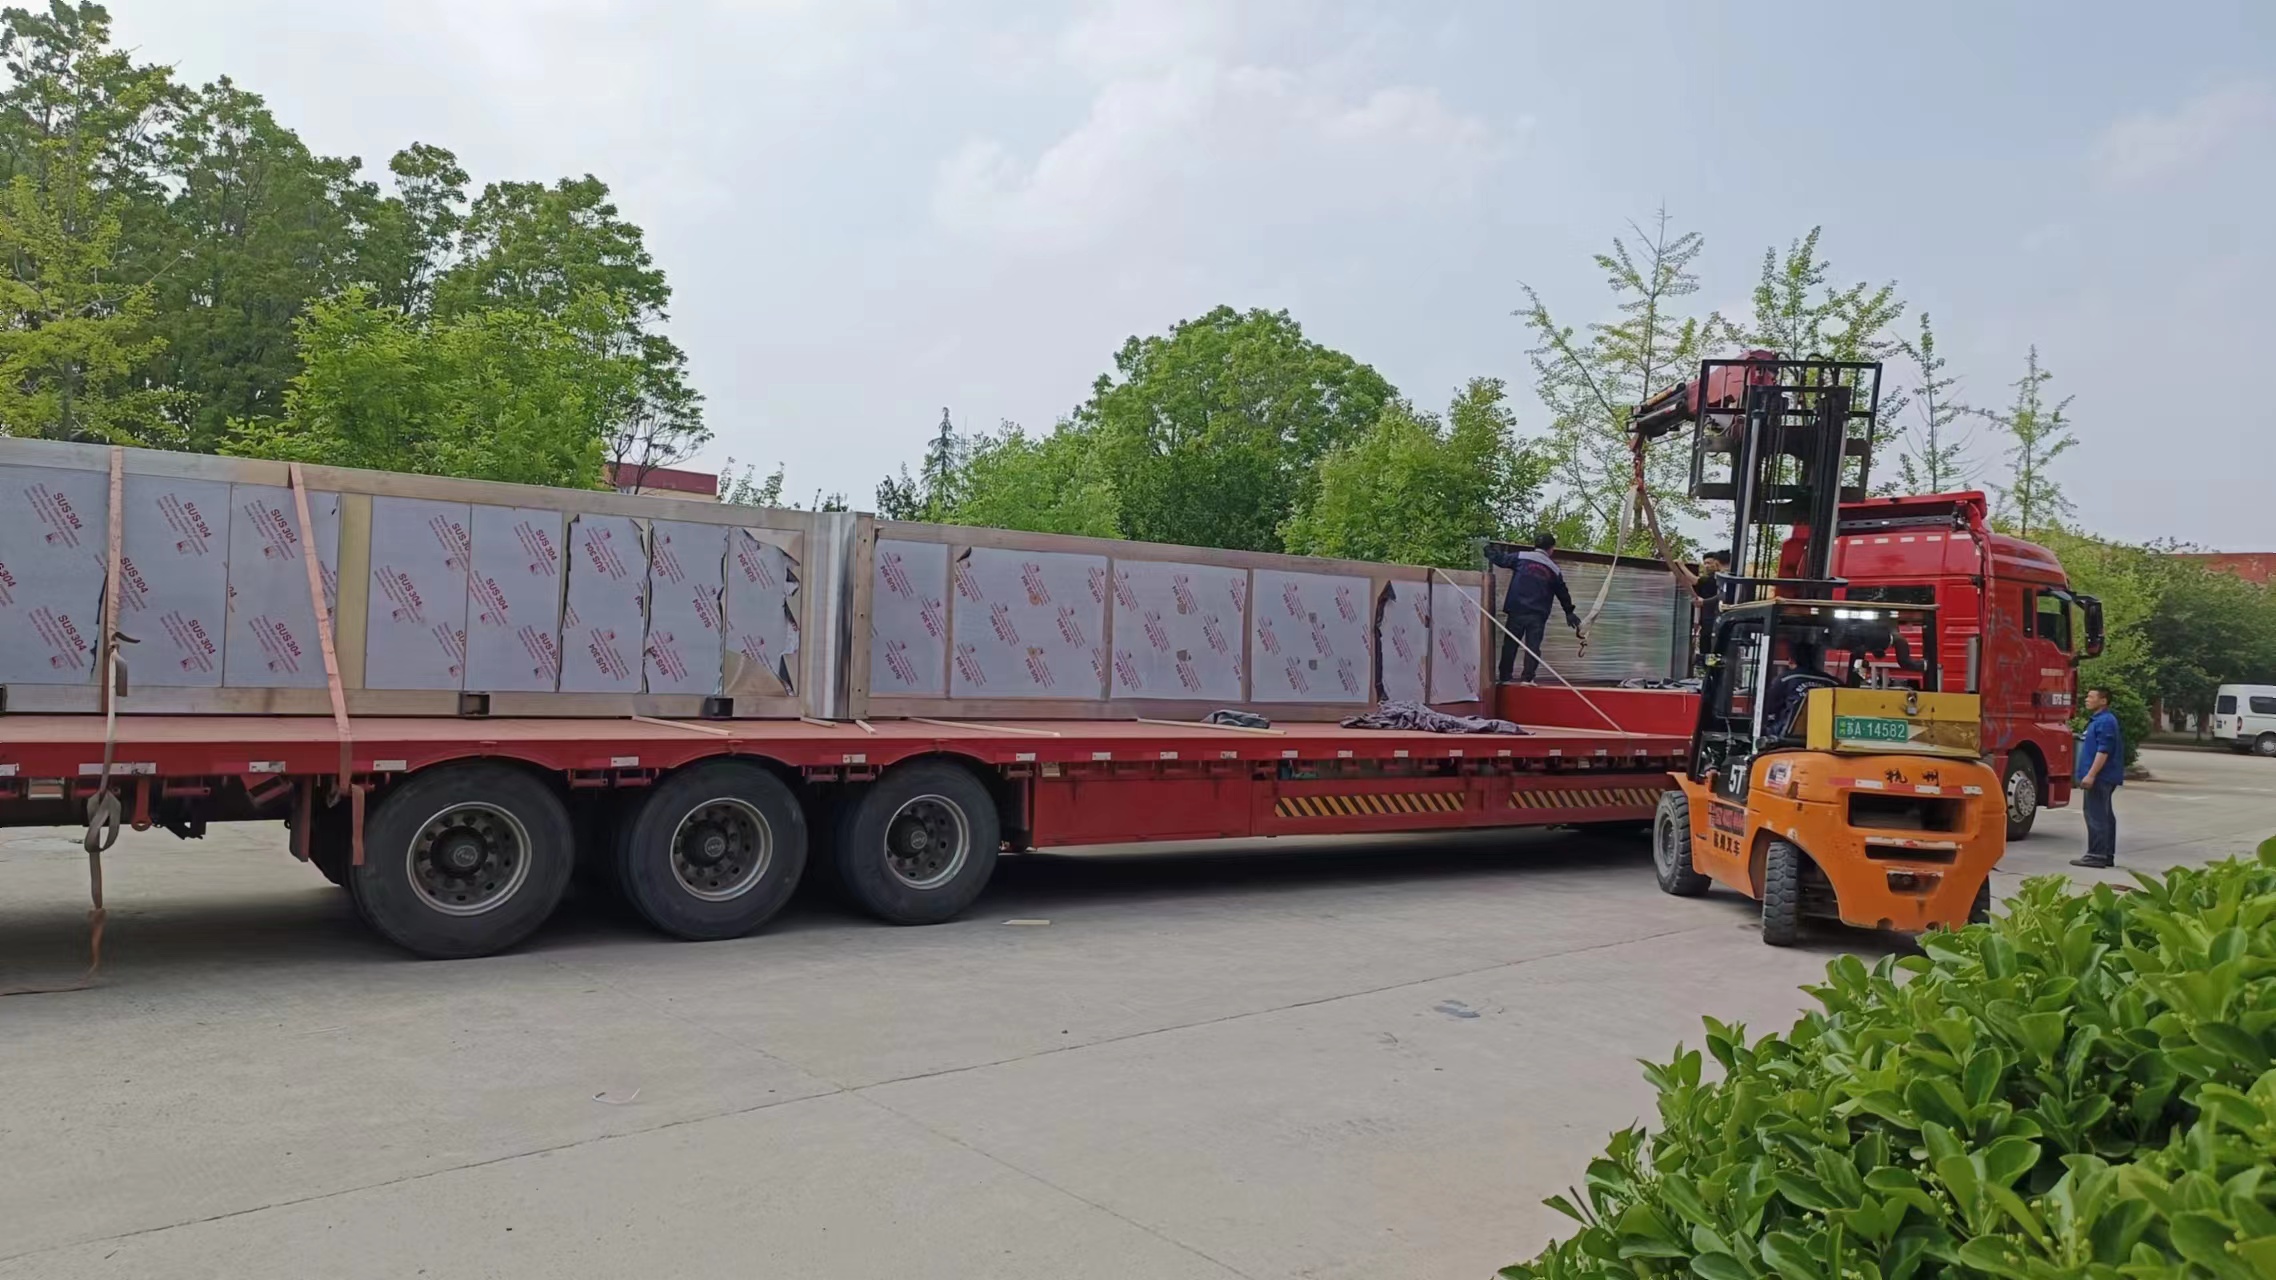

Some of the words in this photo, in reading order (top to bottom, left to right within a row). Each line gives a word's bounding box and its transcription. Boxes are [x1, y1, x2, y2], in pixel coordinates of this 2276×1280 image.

[54, 492, 72, 513] SUS
[66, 512, 82, 530] 304
[184, 502, 202, 522] SUS
[196, 522, 212, 538] 304
[270, 508, 288, 528] SUS
[282, 528, 298, 544] 304
[452, 522, 467, 541] SUS
[536, 529, 550, 547] SUS
[545, 546, 557, 560] 304
[120, 558, 138, 577] SUS
[133, 577, 148, 593] 304
[399, 573, 414, 592] SUS
[409, 590, 422, 606] 304
[486, 578, 500, 596] SUS
[496, 595, 508, 610] 304
[58, 615, 76, 635] SUS
[71, 634, 87, 651] 304
[189, 620, 206, 639] SUS
[200, 638, 216, 654] 304
[275, 623, 292, 642] SUS
[287, 641, 302, 656] 304
[540, 632, 554, 650] SUS
[1728, 764, 1747, 794] 5T
